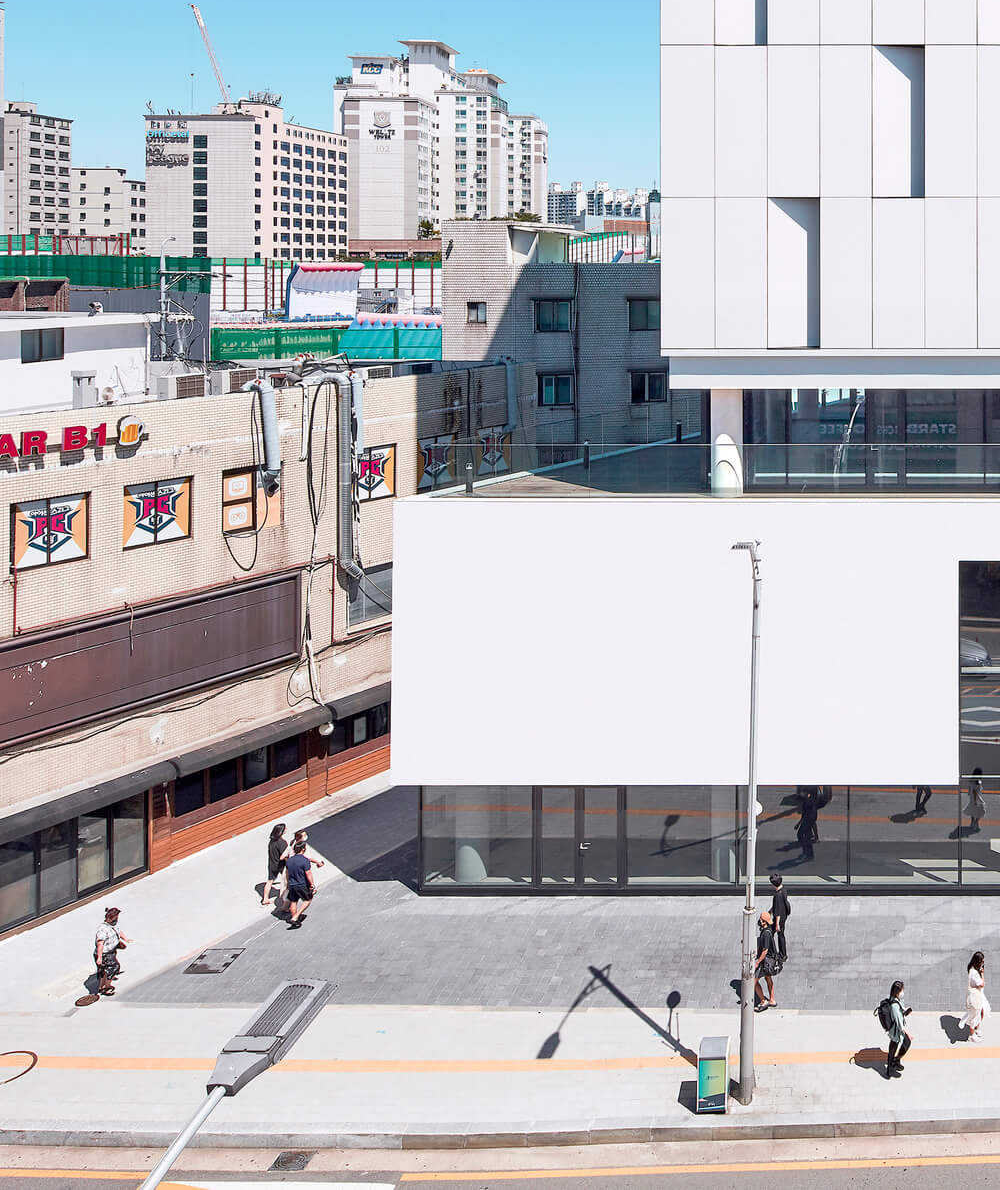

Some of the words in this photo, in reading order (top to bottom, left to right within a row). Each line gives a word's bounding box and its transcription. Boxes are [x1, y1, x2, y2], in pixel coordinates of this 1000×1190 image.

[62, 422, 107, 451] B1
[142, 495, 170, 519] PC
[34, 513, 66, 539] PC
